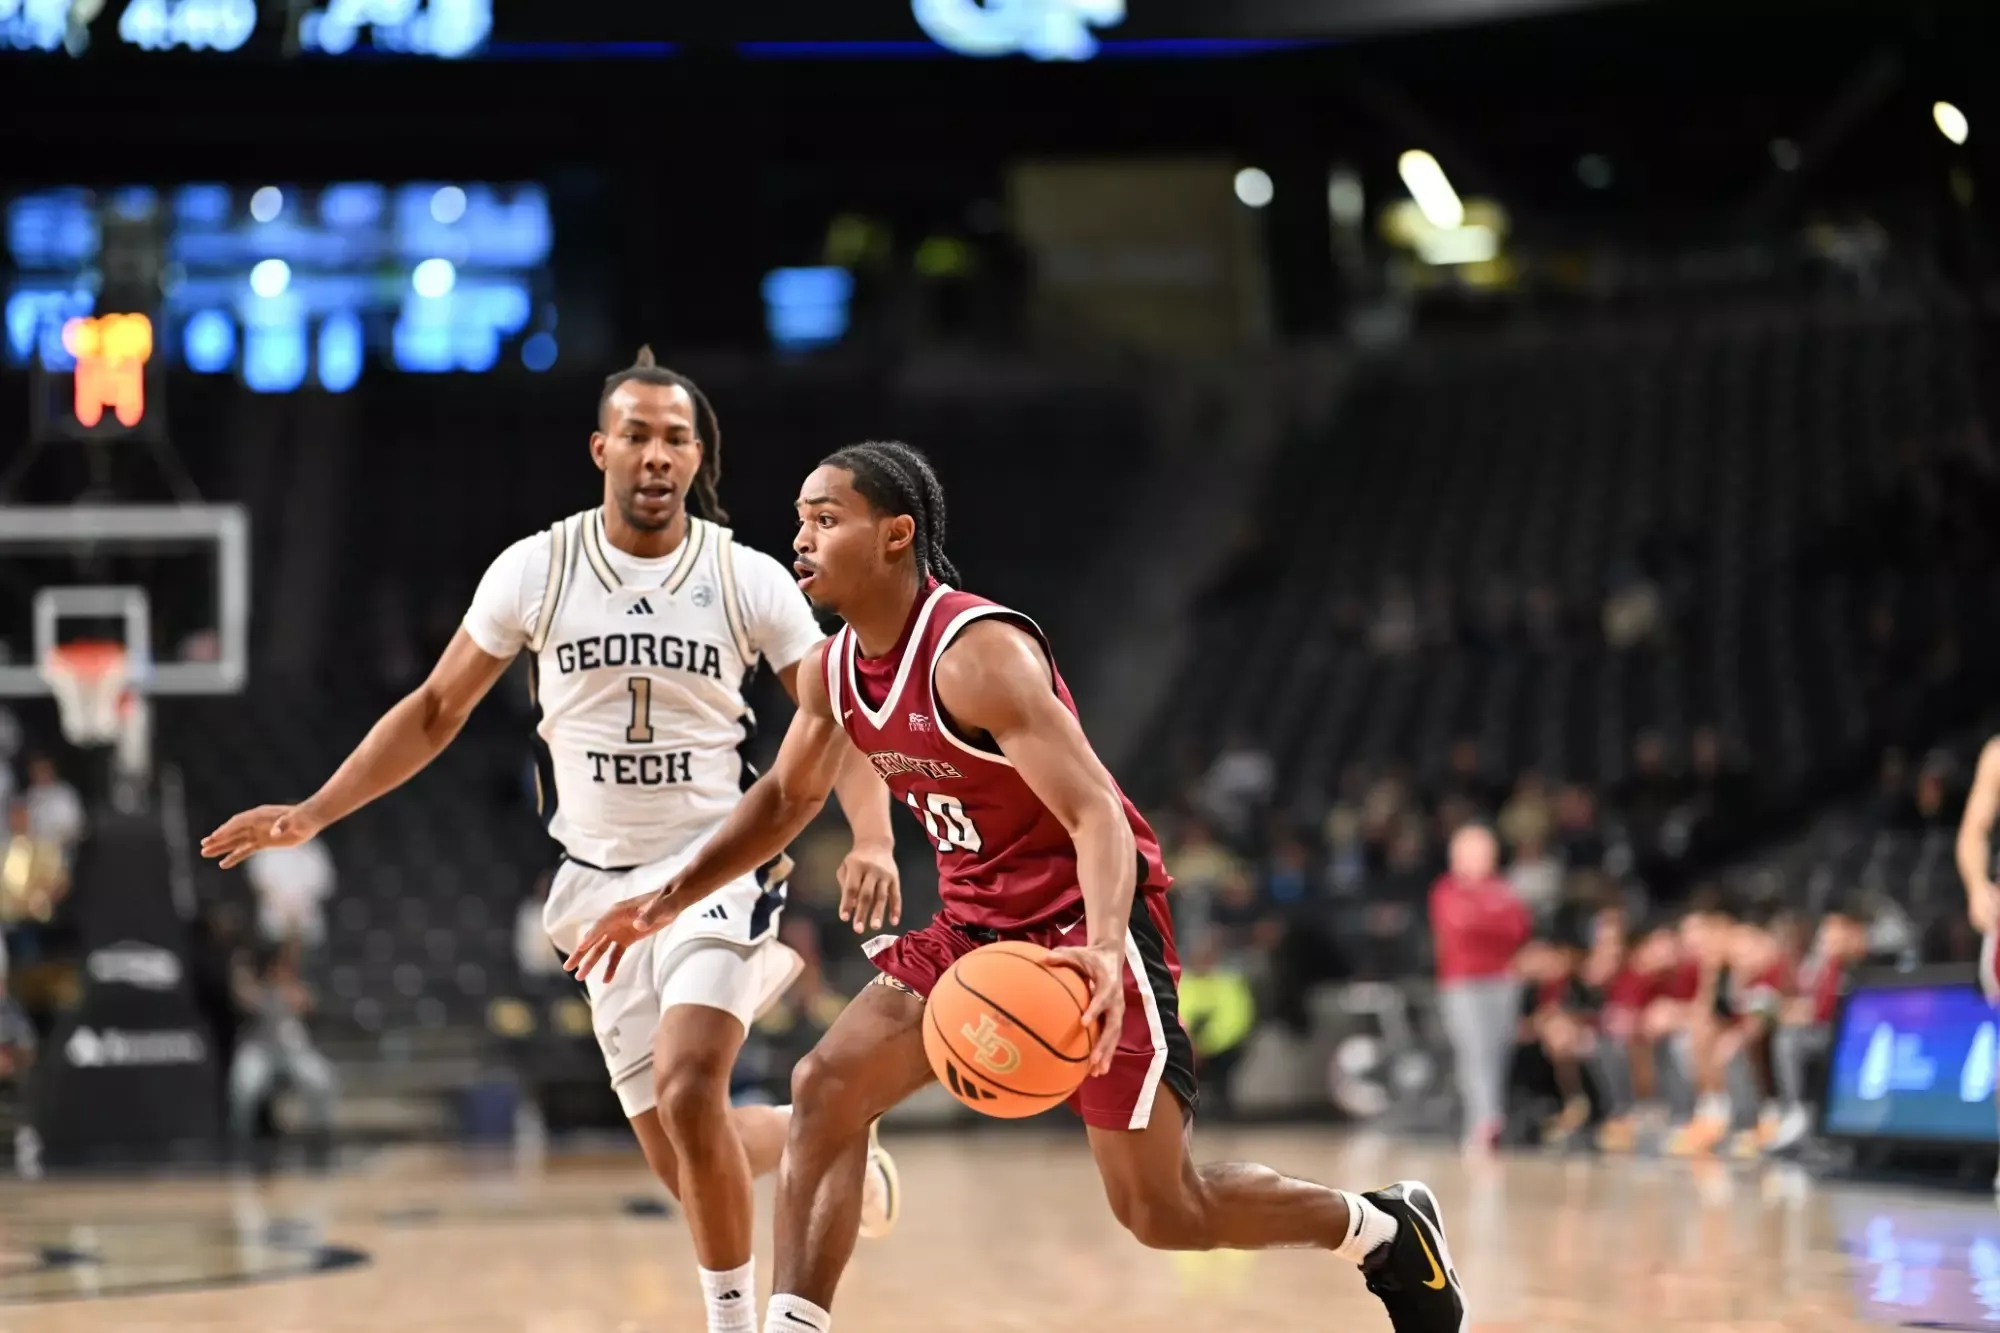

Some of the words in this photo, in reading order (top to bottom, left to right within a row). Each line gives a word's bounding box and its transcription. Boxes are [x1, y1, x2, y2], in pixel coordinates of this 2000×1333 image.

[556, 633, 722, 680] GEORGIA
[626, 677, 653, 743] 1
[587, 751, 692, 785] TECH
[906, 789, 984, 853] 10
